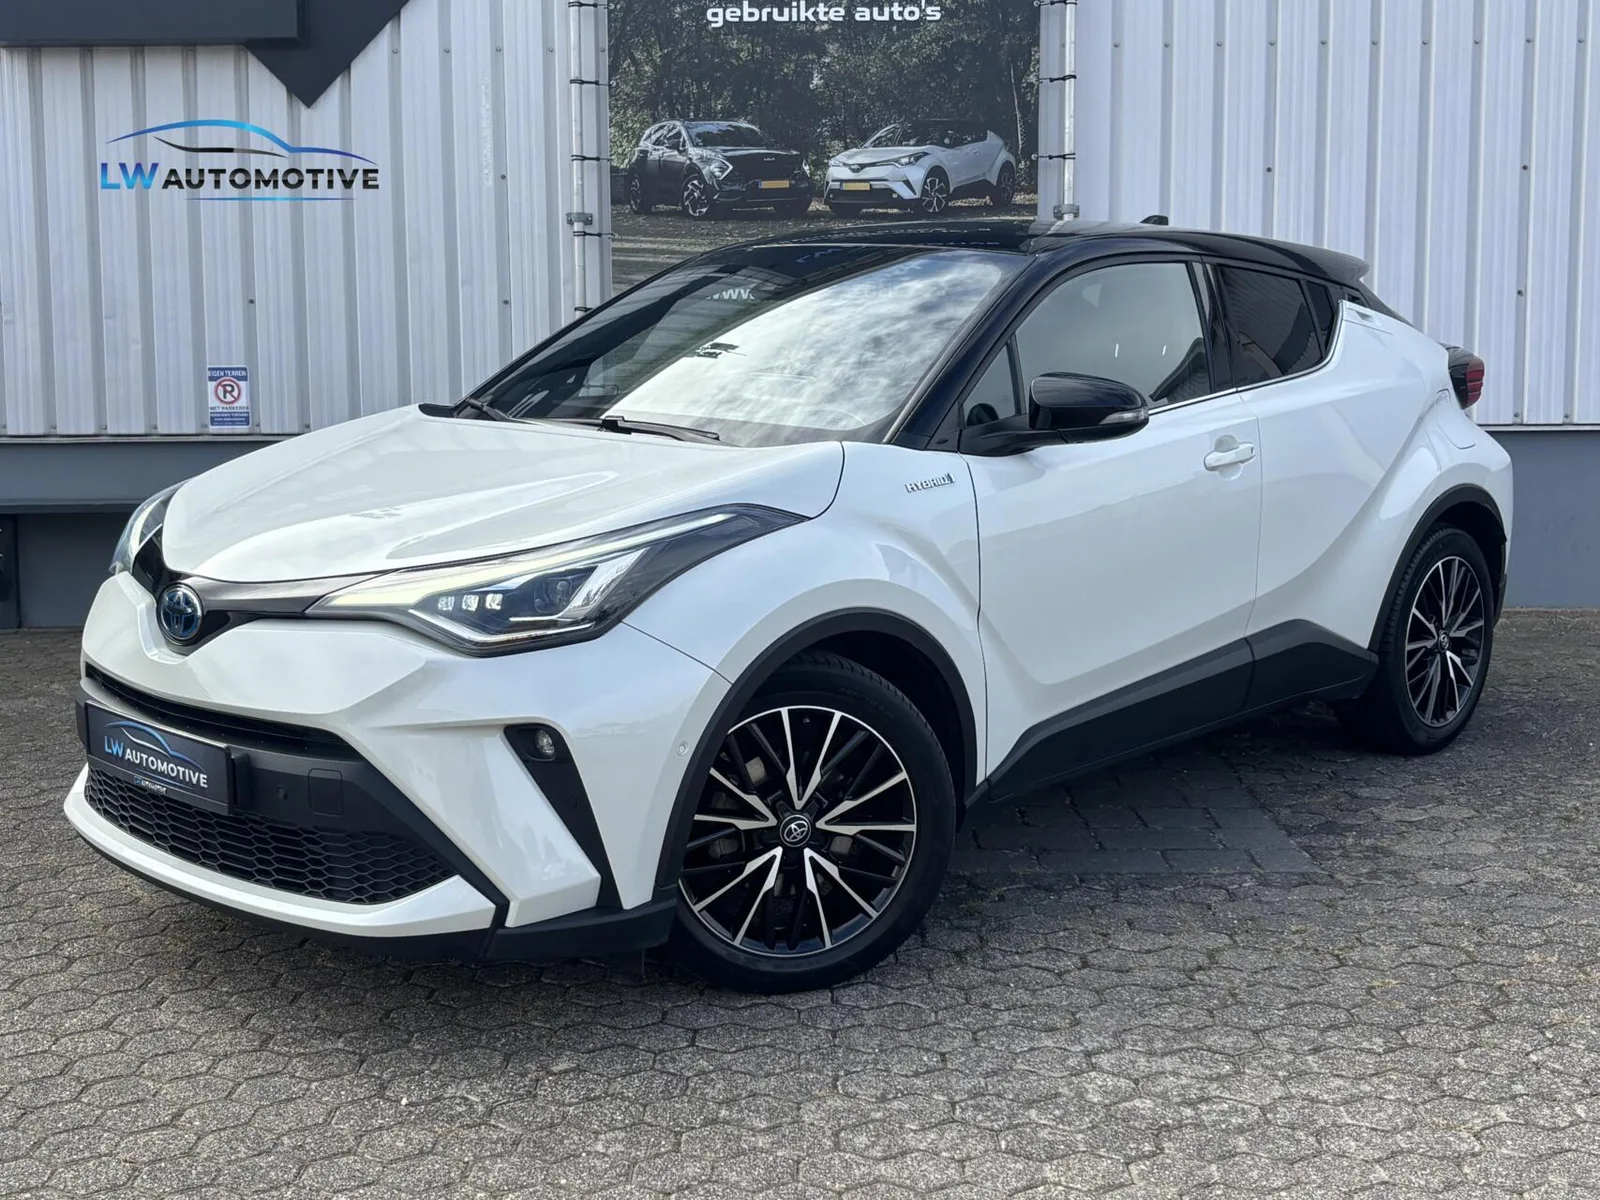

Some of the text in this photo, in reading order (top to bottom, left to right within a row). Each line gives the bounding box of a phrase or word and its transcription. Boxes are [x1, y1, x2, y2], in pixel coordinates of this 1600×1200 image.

[706, 0, 942, 28] gebruikte auto's
[100, 162, 380, 190] LW AUTOMOTIVE
[904, 476, 948, 493] HYBRID
[104, 735, 208, 789] LW AUTOMOTIVE
